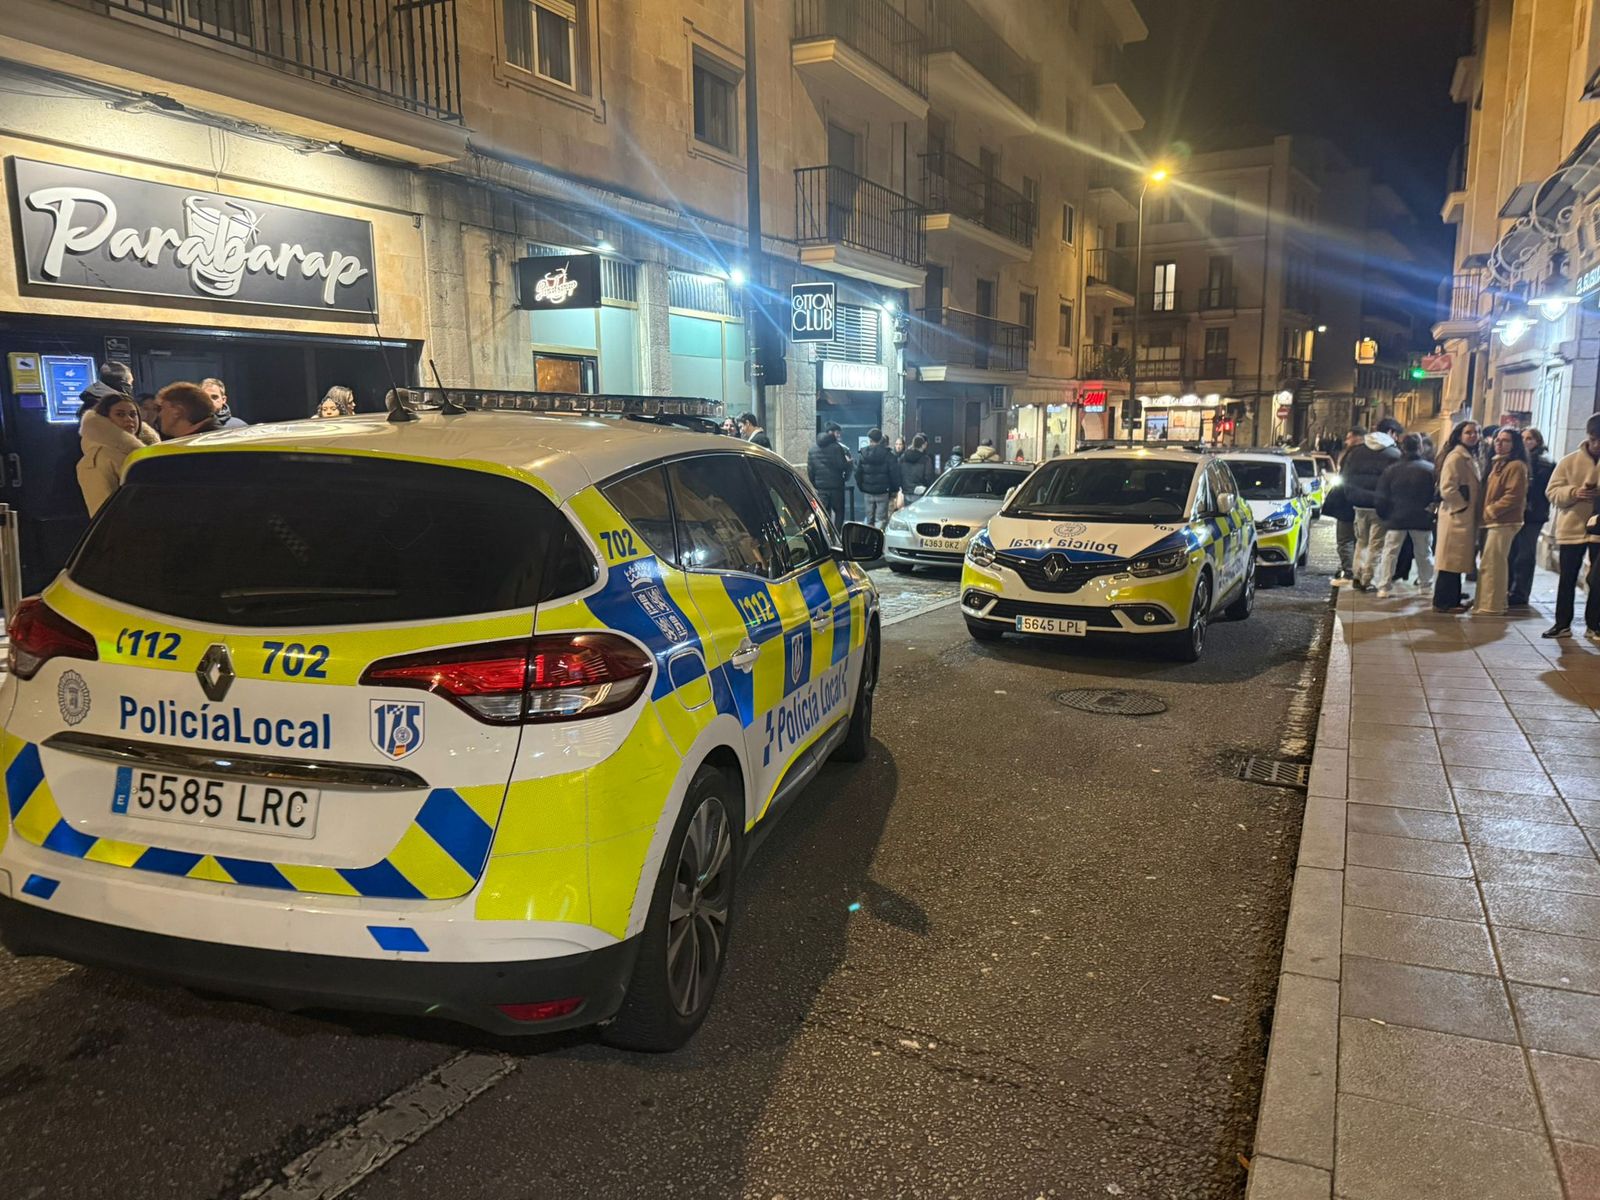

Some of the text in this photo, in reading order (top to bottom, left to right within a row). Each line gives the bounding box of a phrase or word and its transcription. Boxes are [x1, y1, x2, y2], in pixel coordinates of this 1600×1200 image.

[29, 187, 368, 304] Parabarap
[792, 293, 833, 311] COTTON
[792, 309, 833, 331] CLUB
[599, 528, 638, 560] 702
[1024, 618, 1082, 633] 5645 LPL
[128, 630, 181, 660] 112
[262, 641, 330, 678] 702
[778, 663, 842, 752] Policía Local
[374, 704, 420, 755] 175
[138, 773, 308, 828] 5585 LRC
